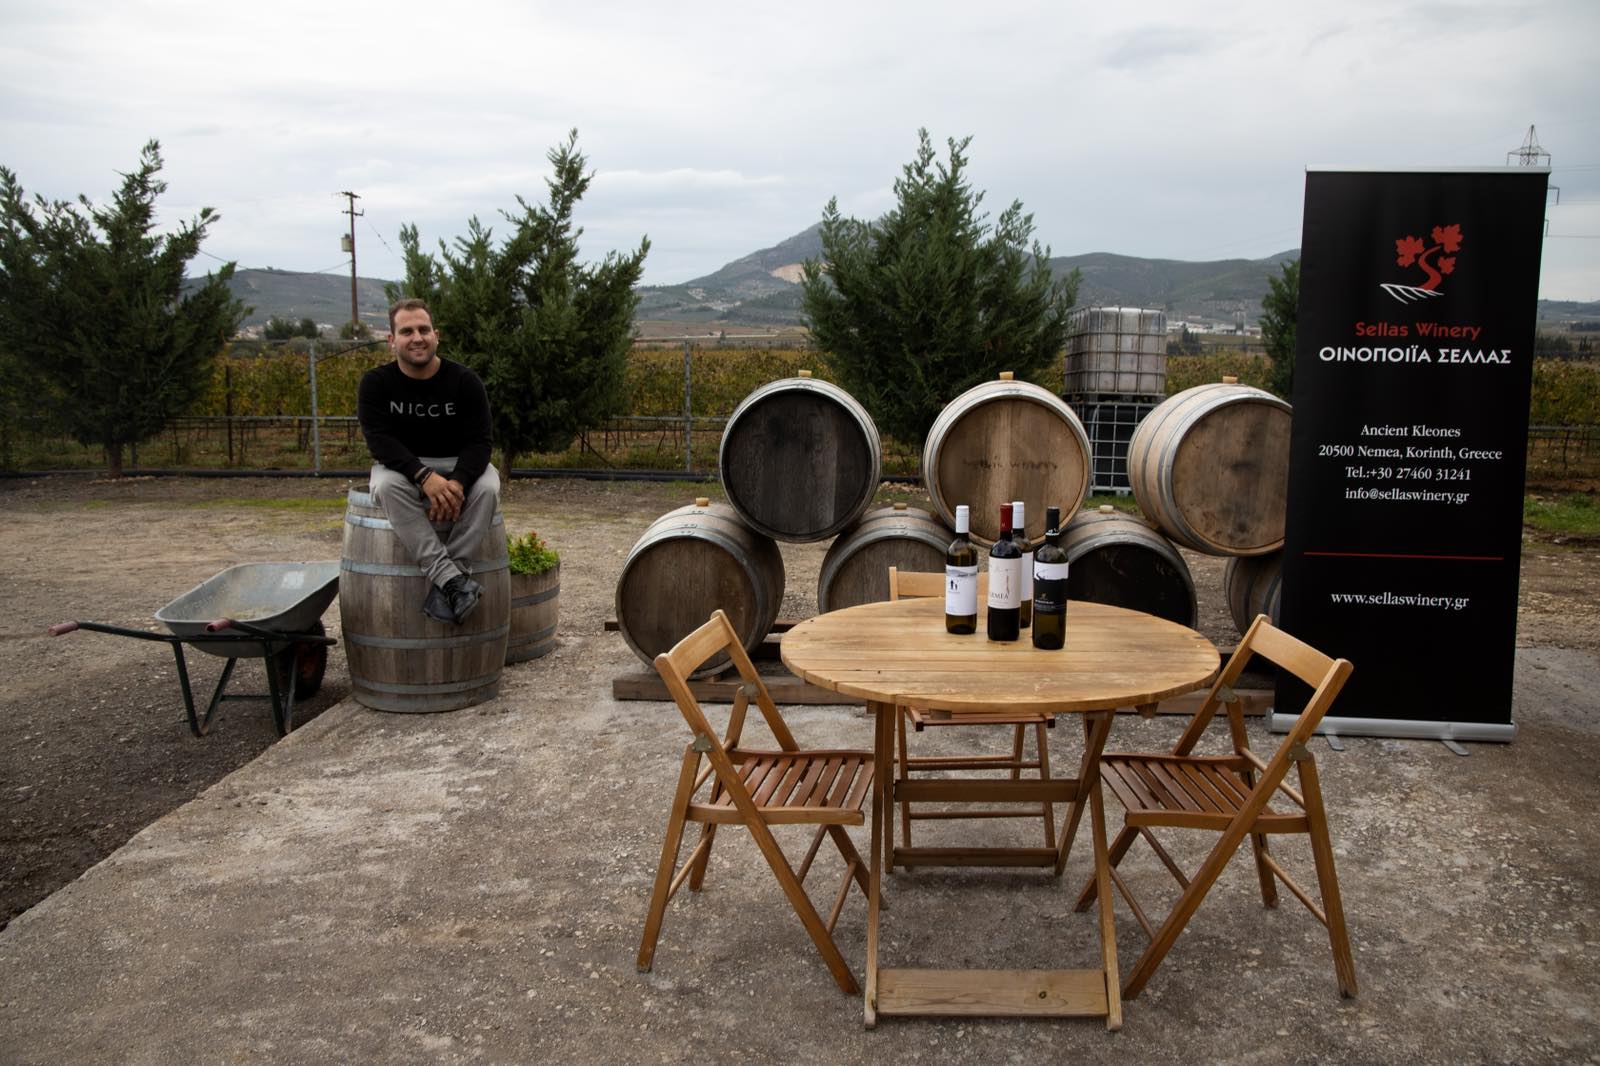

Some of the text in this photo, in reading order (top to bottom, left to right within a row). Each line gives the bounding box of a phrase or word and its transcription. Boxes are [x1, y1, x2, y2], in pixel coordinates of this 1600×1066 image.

[1355, 321, 1481, 341] Sellas Winery
[1437, 348, 1512, 364] ΣΕΛΛΑΣ
[390, 400, 457, 417] NICCE
[1360, 424, 1461, 438] Ancient Kleones
[1318, 444, 1503, 461] 20500 Nemea, Korinth, Greece
[1396, 466, 1433, 480] 27460
[1435, 467, 1471, 481] 31241
[1345, 487, 1470, 505] info@sellaswinery.gr
[1331, 591, 1470, 611] www.sellaswinery.gr
